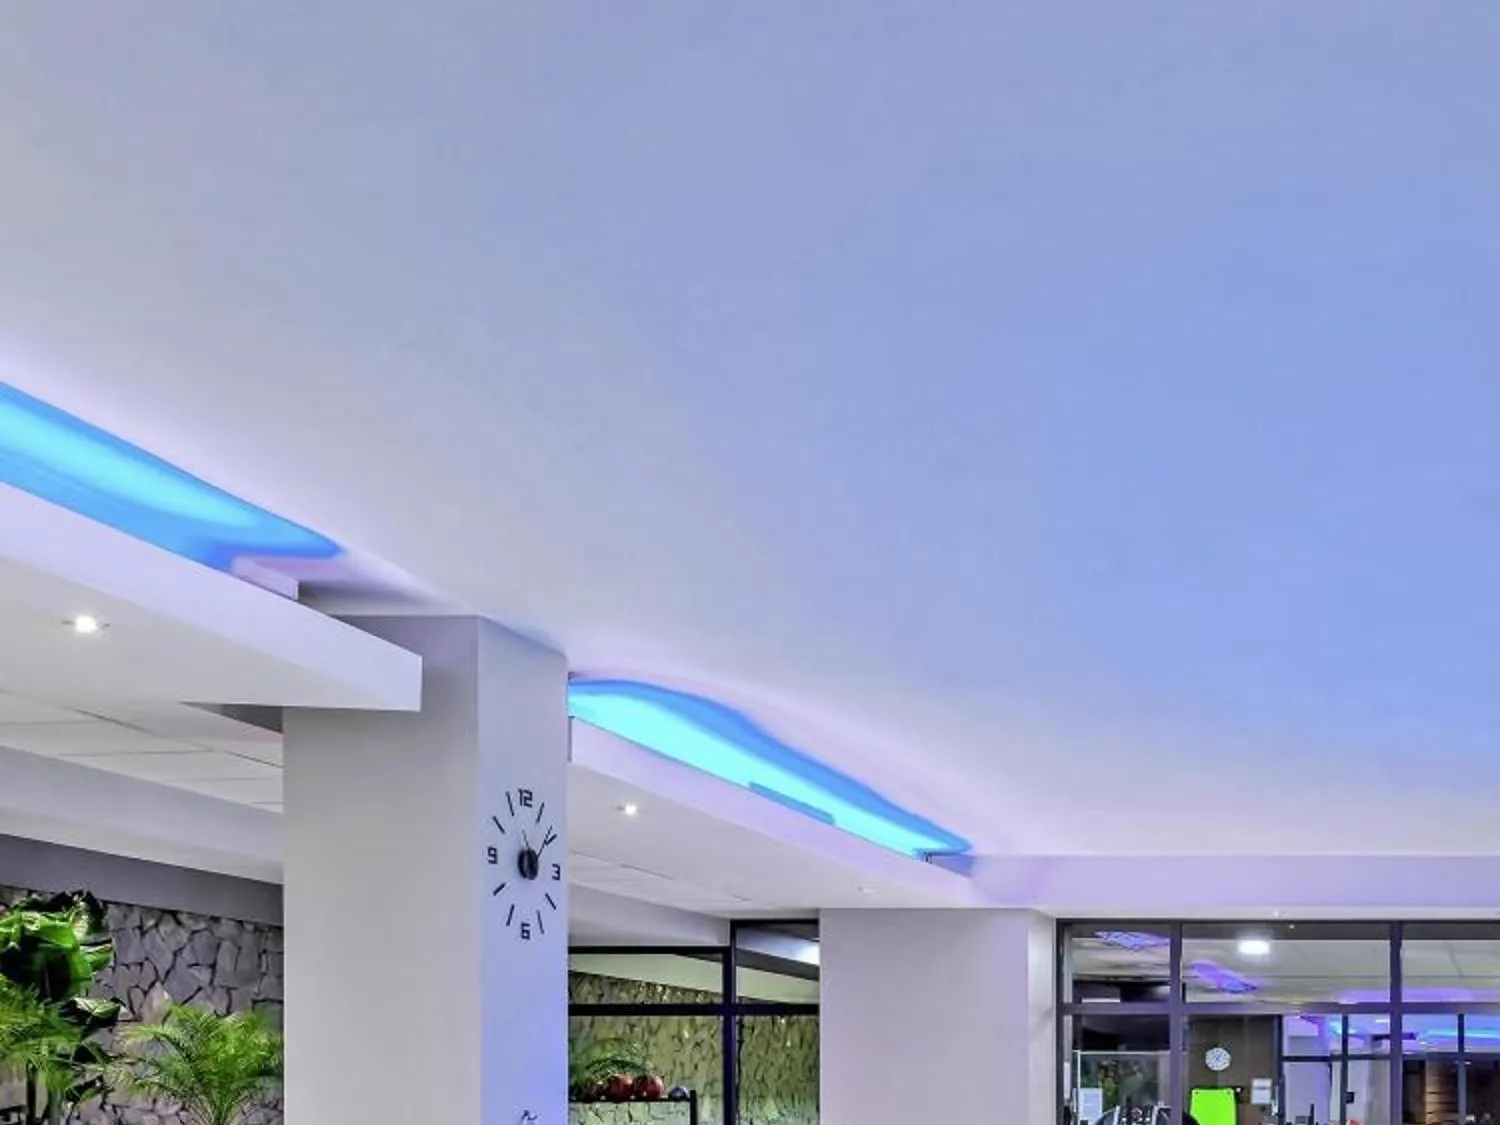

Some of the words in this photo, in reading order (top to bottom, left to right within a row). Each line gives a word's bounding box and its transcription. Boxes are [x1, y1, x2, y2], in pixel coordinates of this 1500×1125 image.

[518, 788, 533, 808] 12
[487, 846, 498, 864] 9
[551, 863, 561, 881] 3
[520, 922, 531, 940] 6
